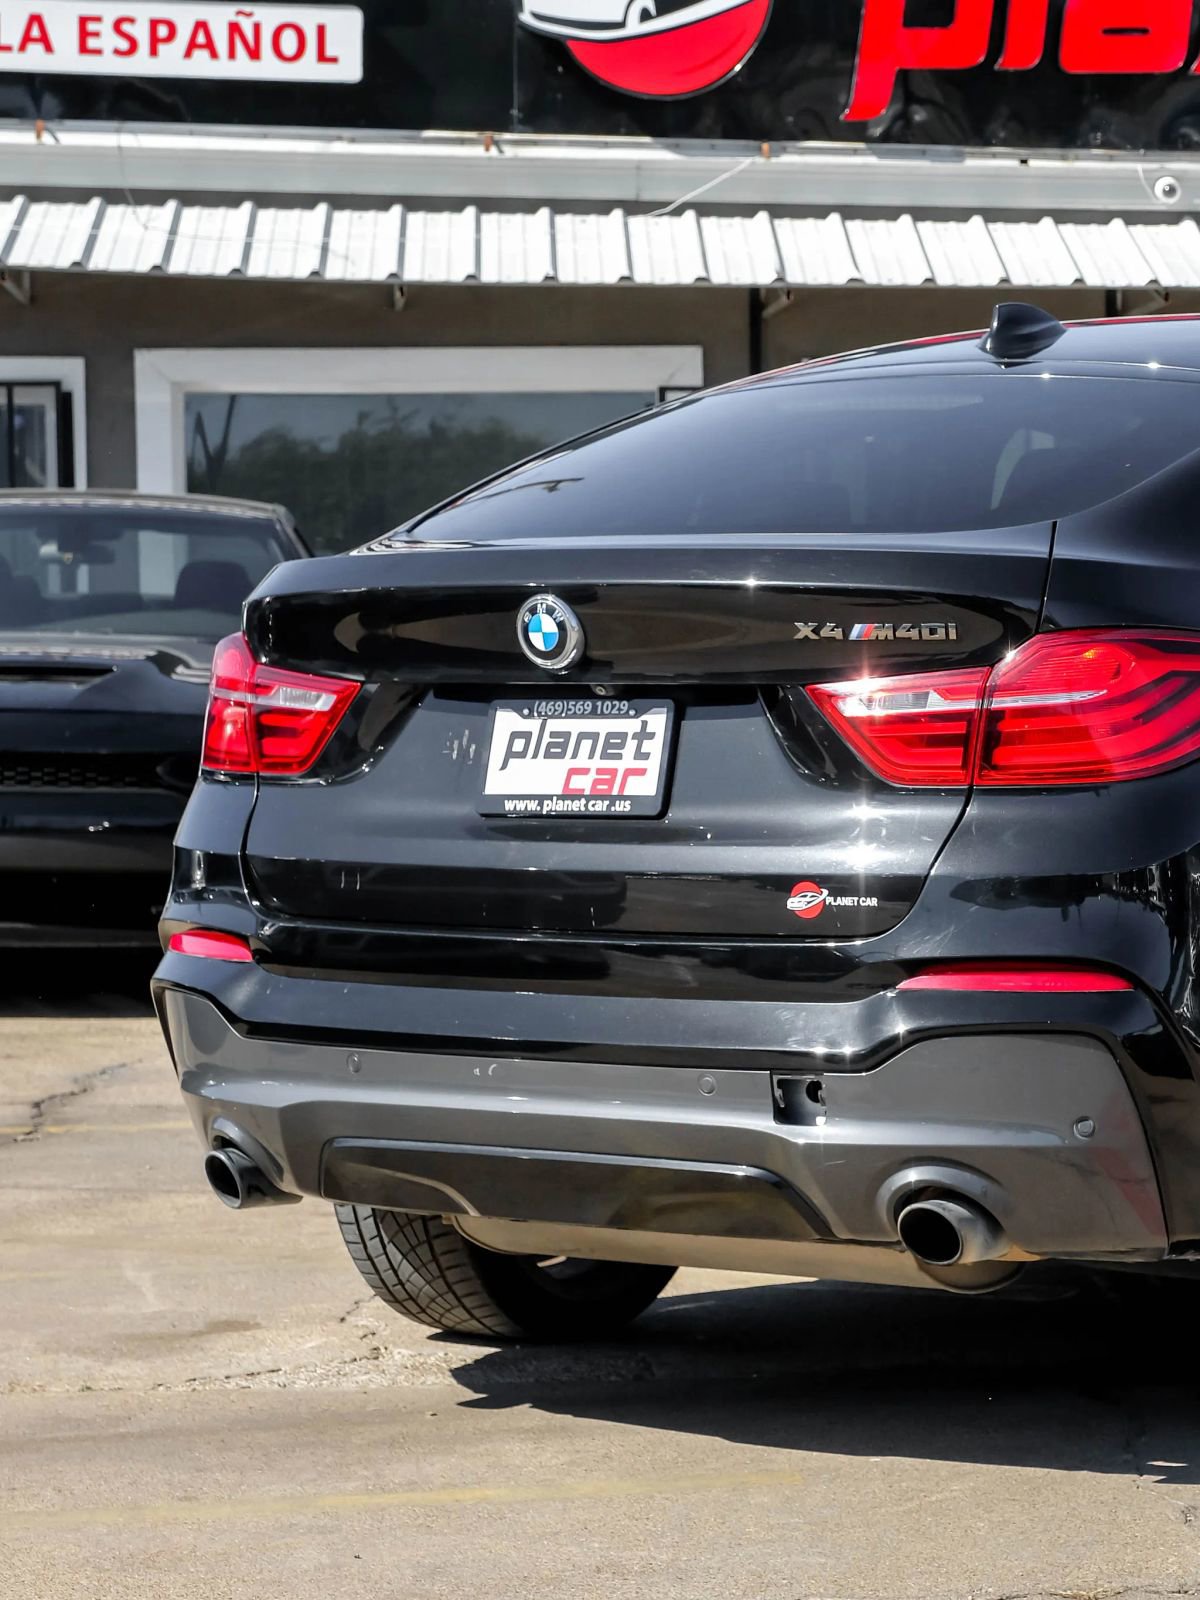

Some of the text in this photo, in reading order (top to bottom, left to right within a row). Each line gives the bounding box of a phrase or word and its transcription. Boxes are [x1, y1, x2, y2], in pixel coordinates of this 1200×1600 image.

[78, 9, 339, 64] ESPAÑOL
[523, 602, 565, 623] BMW
[794, 622, 844, 640] X4
[596, 700, 629, 714] 1029
[499, 719, 656, 771] planet
[562, 767, 648, 796] car
[826, 896, 878, 907] PLANET CAR
